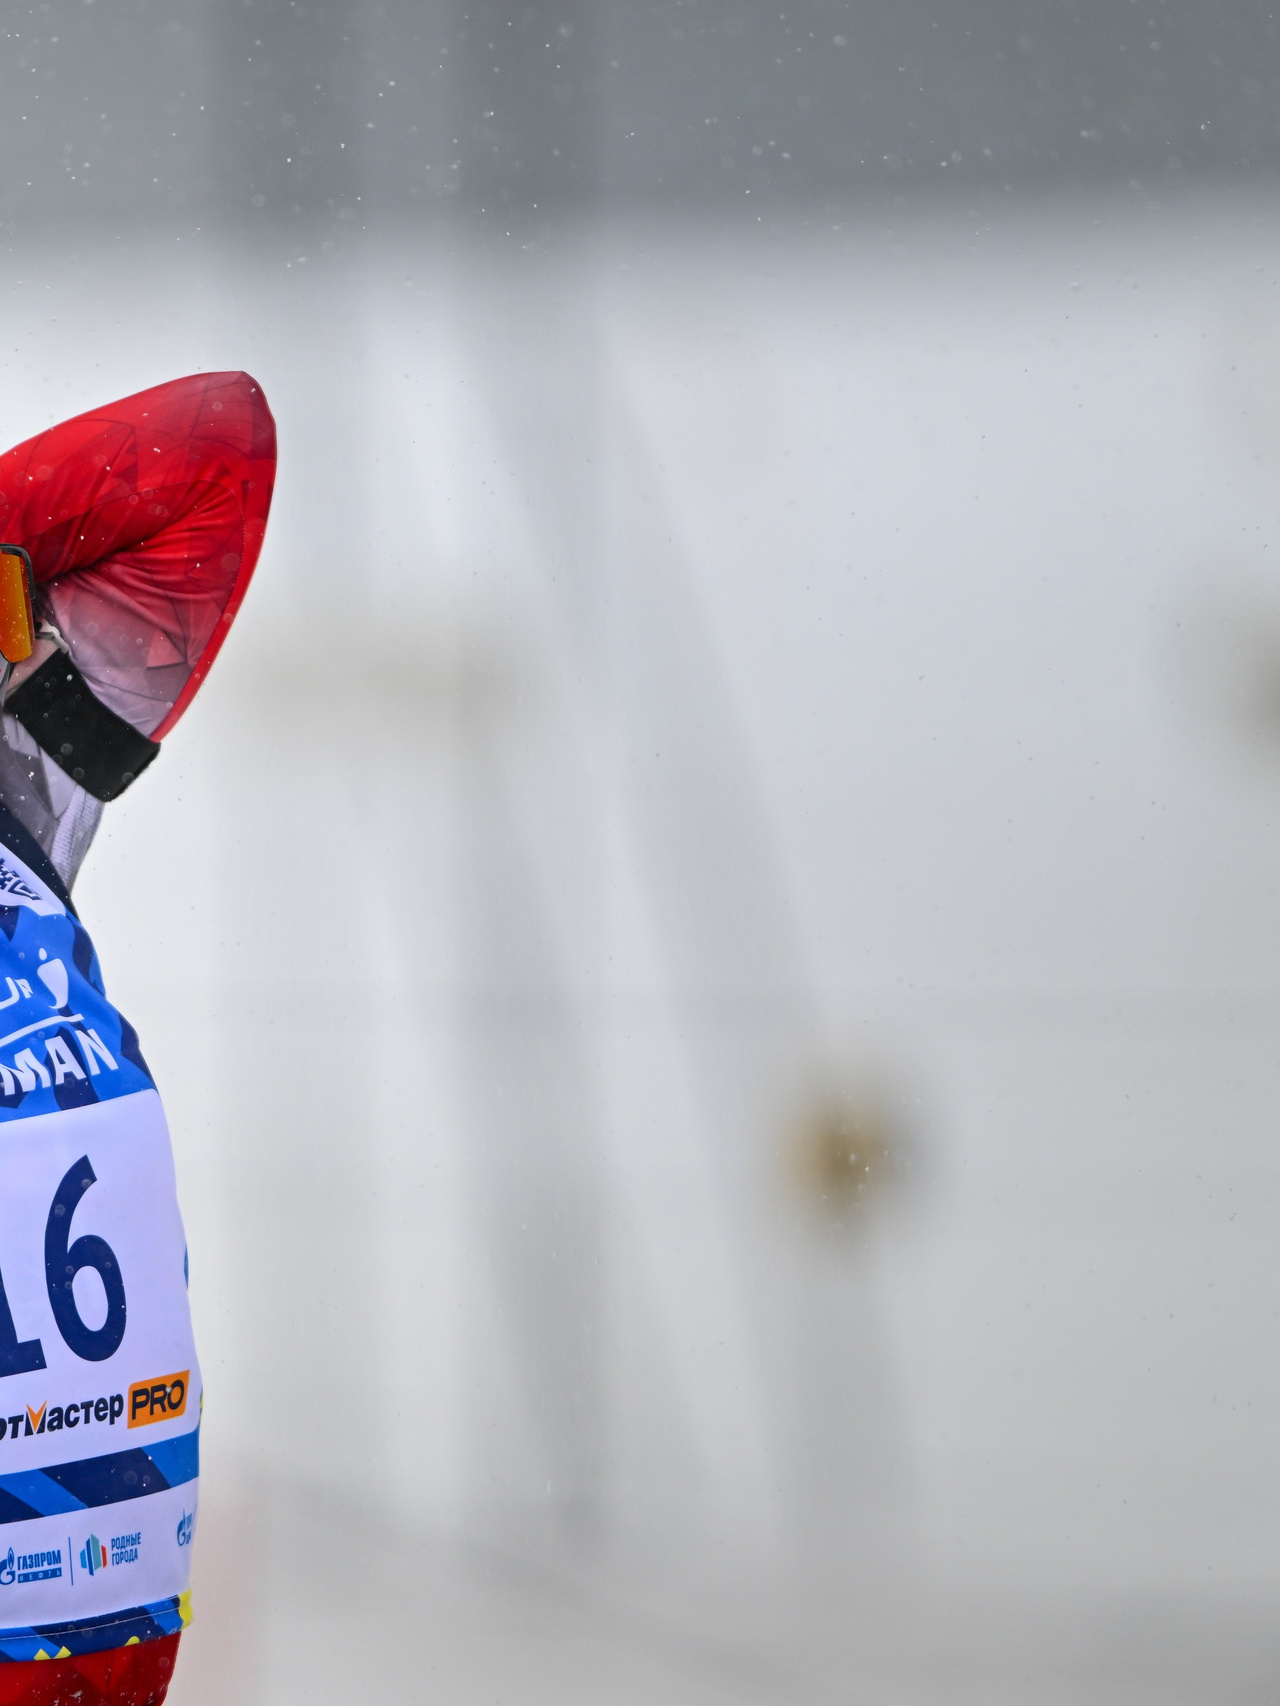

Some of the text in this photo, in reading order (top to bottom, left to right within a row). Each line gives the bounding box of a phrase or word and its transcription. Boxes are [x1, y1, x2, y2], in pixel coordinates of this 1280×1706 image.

[131, 1378, 186, 1420] PRO
[111, 1531, 141, 1551] РОДНЫЕ
[17, 1549, 62, 1571] ГАЗПРОМ
[111, 1548, 138, 1566] ГОРОДА
[19, 1569, 61, 1582] НЕФТЬ
